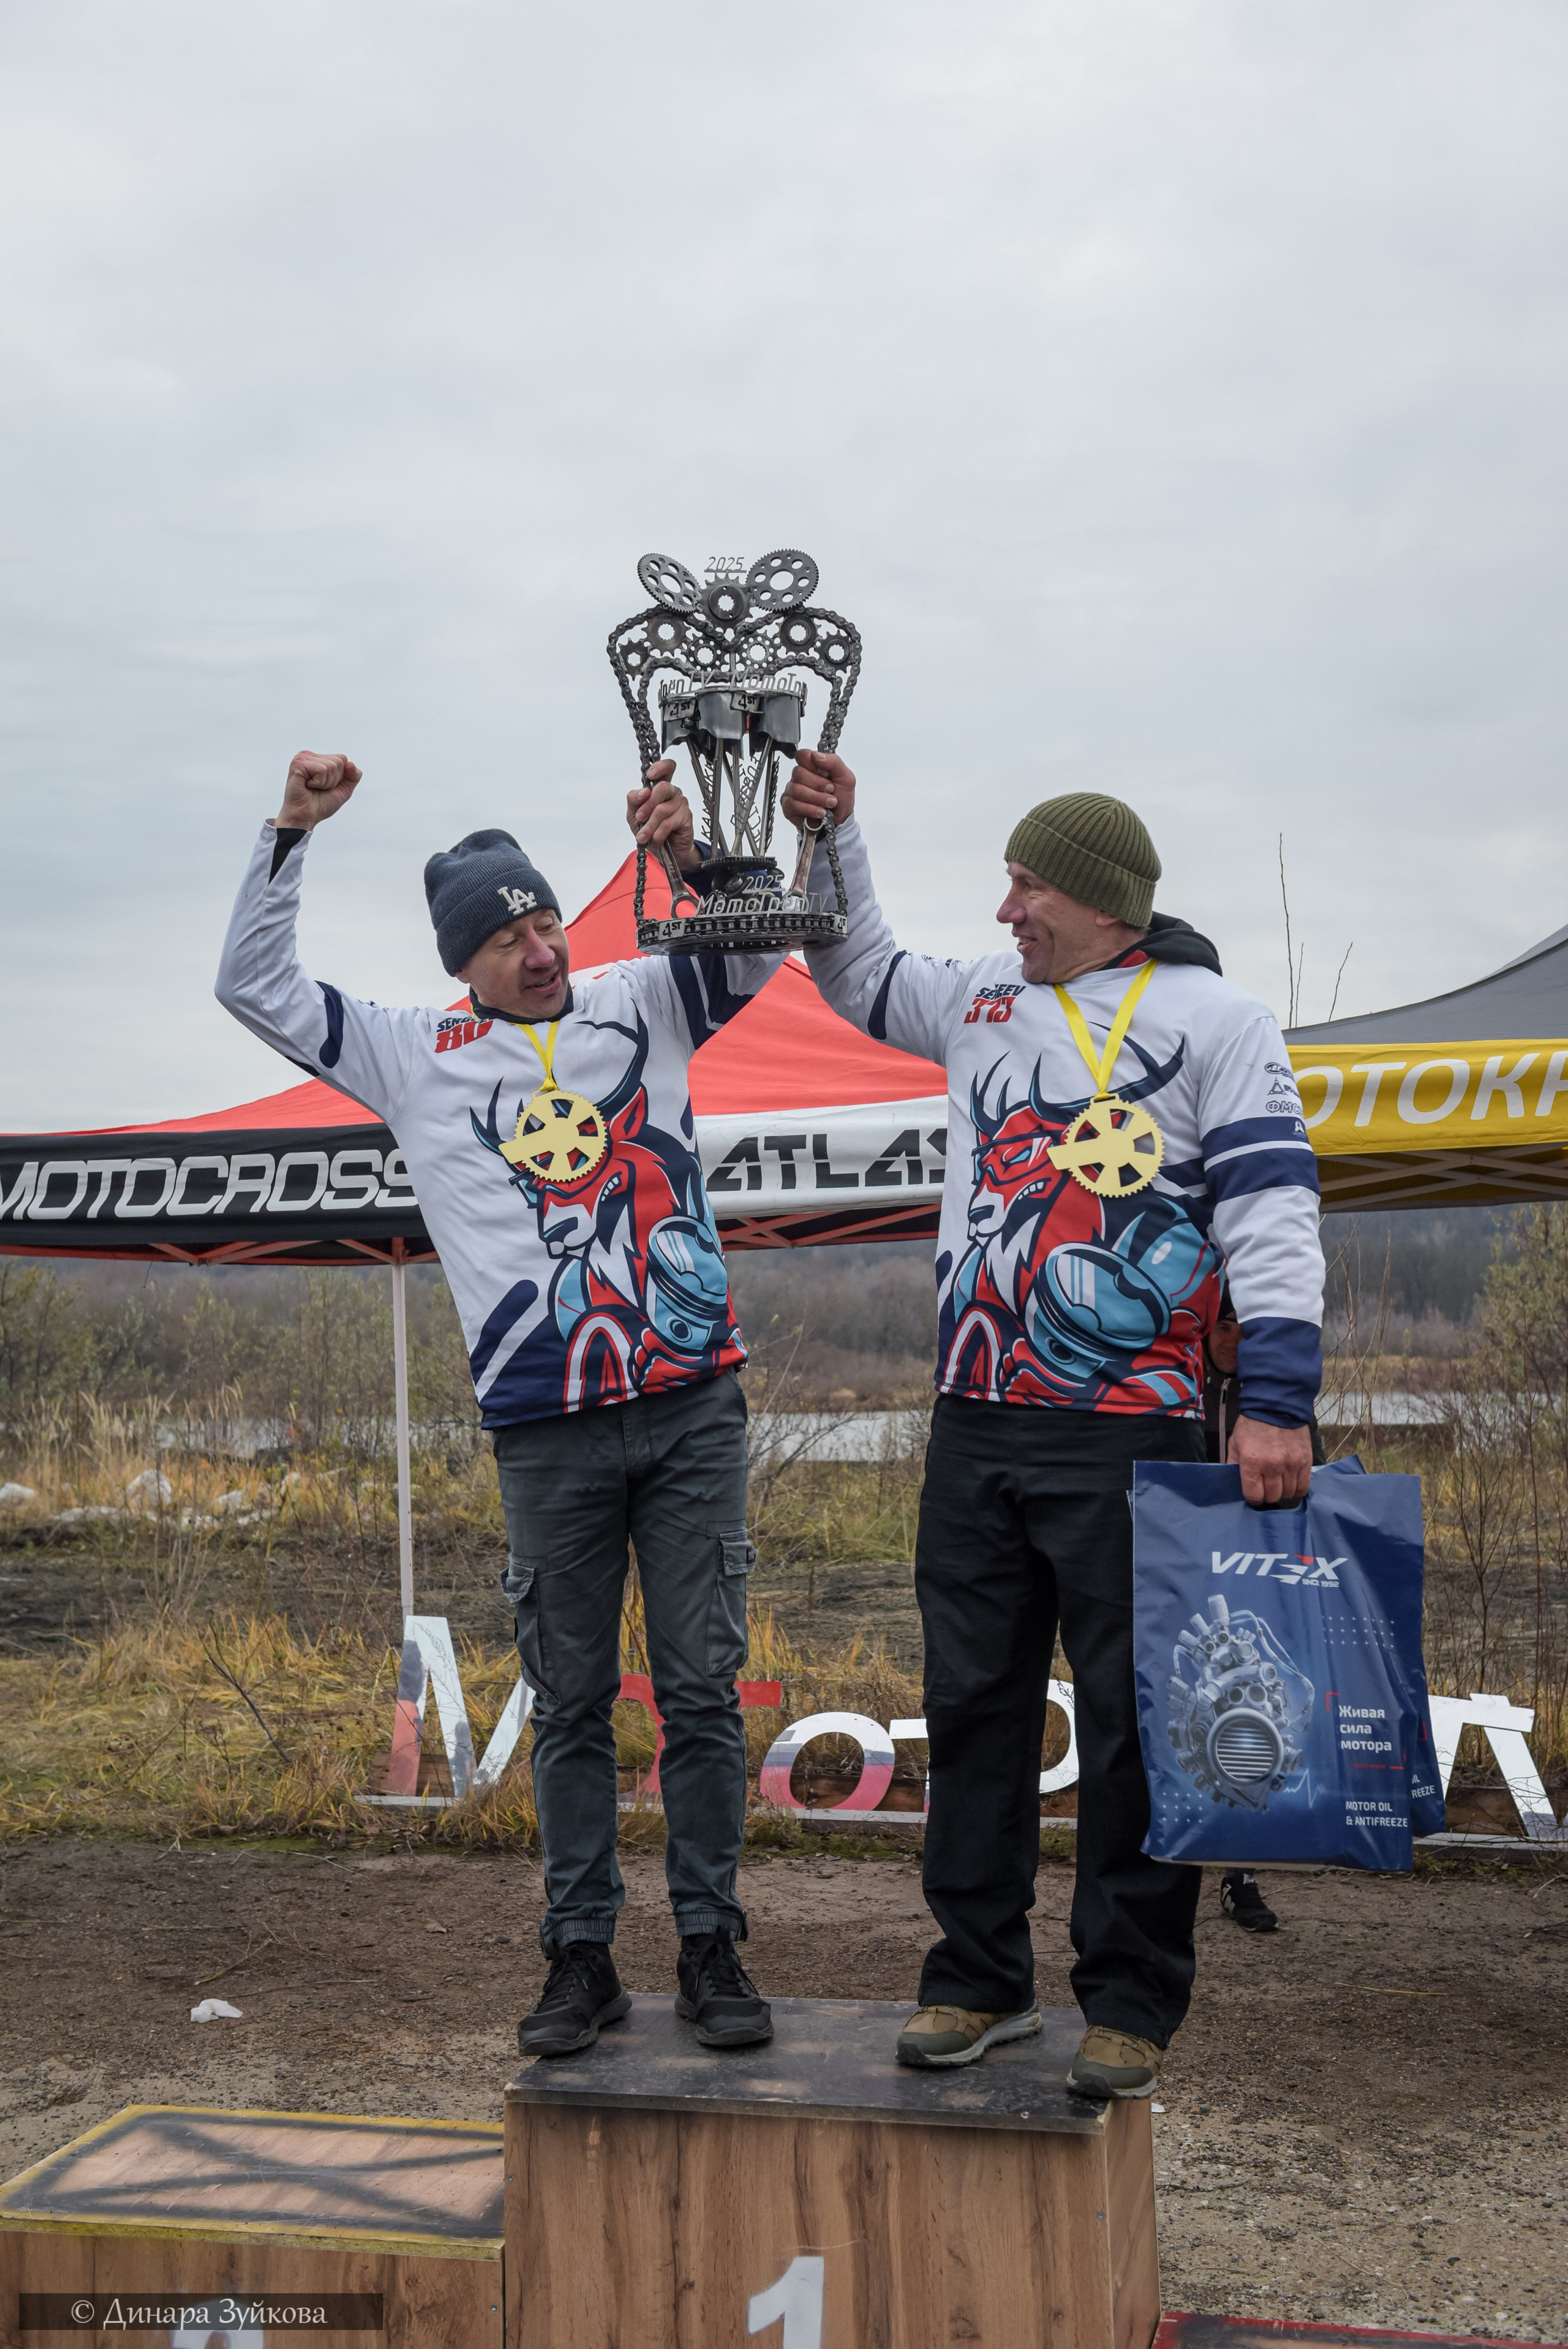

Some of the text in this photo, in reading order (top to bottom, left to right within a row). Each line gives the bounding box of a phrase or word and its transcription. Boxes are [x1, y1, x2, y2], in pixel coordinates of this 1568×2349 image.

[706, 556, 744, 570] 2025
[744, 875, 783, 891] 2025
[497, 886, 537, 916] LA
[963, 997, 1016, 1024] 373
[434, 1020, 494, 1054] 80
[1265, 1101, 1303, 1117] ФМС
[0, 1149, 419, 1220] MOTOCROSS
[1212, 1552, 1348, 1585] VITEX
[1338, 1705, 1385, 1719] Живая
[1340, 1724, 1372, 1734] сила
[1341, 1740, 1392, 1754] мотора
[1346, 1801, 1393, 1812] MOTOR OIL
[1346, 1816, 1408, 1827] & ANTIFREEZE
